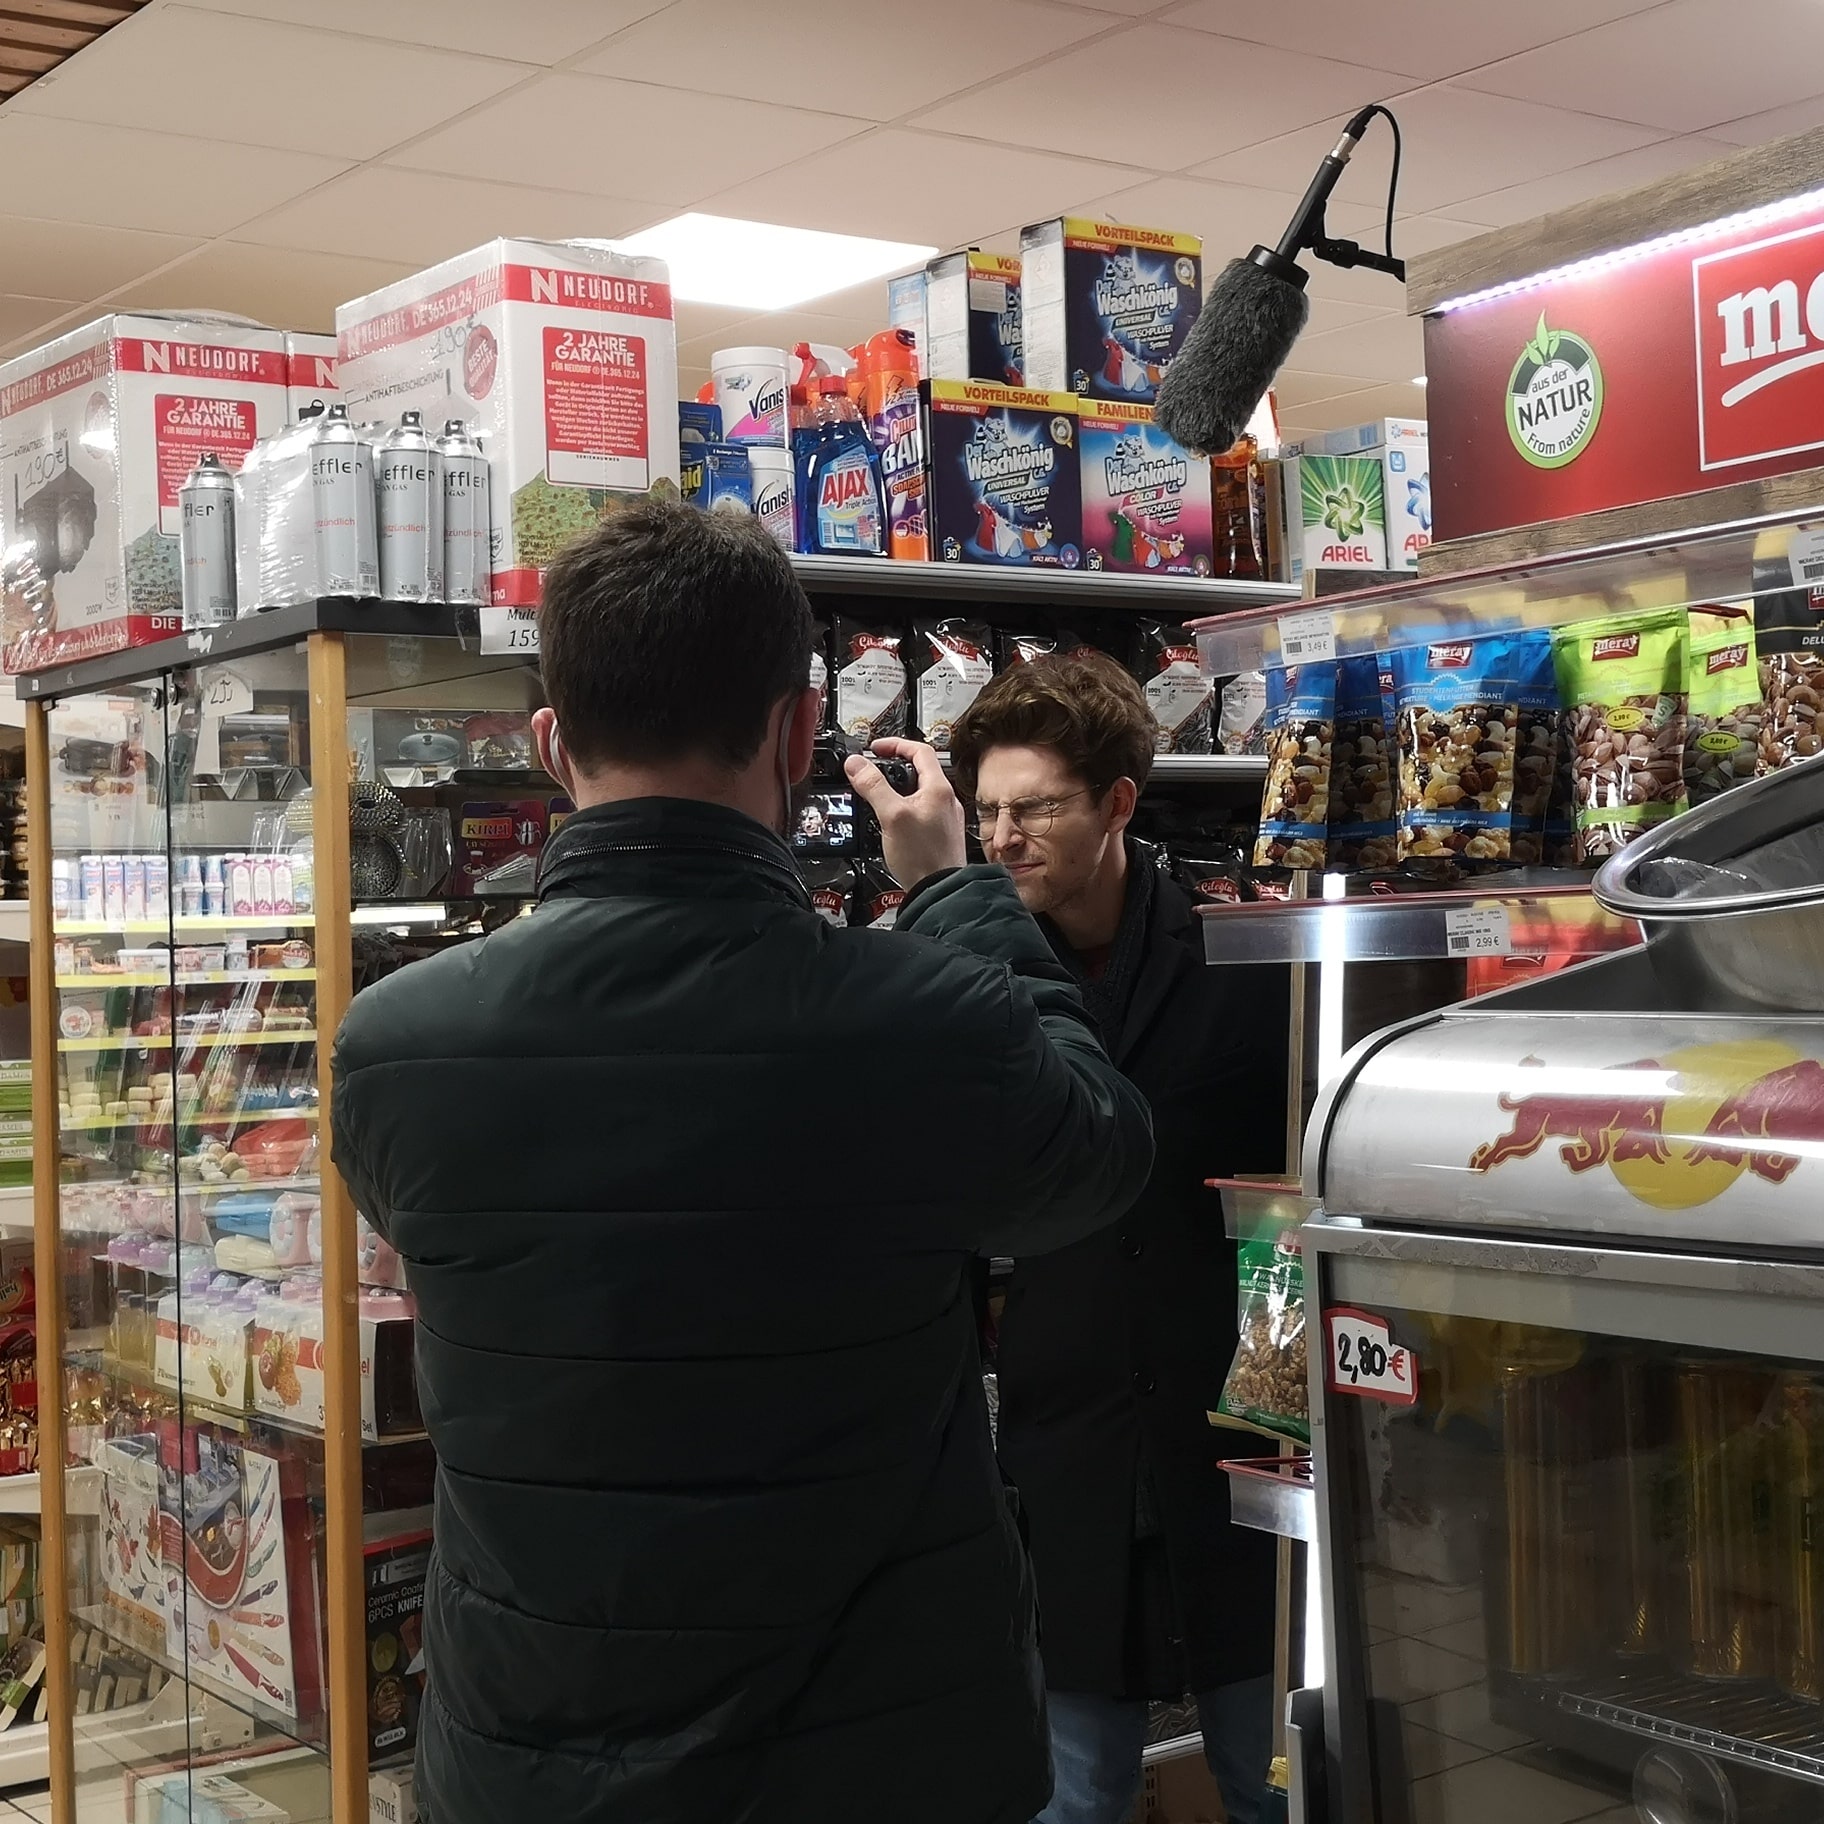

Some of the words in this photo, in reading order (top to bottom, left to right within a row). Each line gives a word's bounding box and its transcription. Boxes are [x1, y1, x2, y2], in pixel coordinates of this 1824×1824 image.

[1095, 224, 1175, 247] VORTEILSPACK
[564, 275, 648, 306] NEUDORF
[1097, 282, 1178, 316] Waschkönig
[1128, 325, 1173, 340] WASCHPULVER
[563, 332, 573, 347] 2
[578, 334, 628, 352] JAHRE
[176, 344, 260, 373] NEUDORF
[467, 338, 489, 372] BESTE
[555, 345, 635, 368] GARANTIE
[564, 362, 591, 374] NEUDORF
[1076, 380, 1087, 391] 30
[1532, 378, 1550, 393] aus
[1552, 368, 1568, 383] der
[964, 386, 1050, 406] VORTEILSPACK
[1518, 378, 1592, 431] NATUR
[175, 398, 185, 411] 2
[190, 399, 238, 416] JAHRE
[167, 411, 245, 429] GARANTIE
[1528, 433, 1555, 454] From
[1559, 409, 1590, 452] nature
[966, 444, 983, 459] Der
[967, 444, 1054, 482] Waschkönig
[1106, 458, 1124, 473] Der
[681, 466, 701, 489] aid
[987, 477, 1026, 490] UNIVERSAL
[1107, 458, 1186, 495] Waschkönig
[822, 467, 870, 509] AJAX
[1000, 486, 1049, 504] WASCHPULVER
[1130, 491, 1157, 502] COLOR
[1023, 503, 1045, 514] System
[1137, 500, 1182, 516] WASCHPULVER
[947, 548, 958, 560] 30
[1321, 545, 1373, 562] ARIEL
[1089, 560, 1099, 570] 30
[152, 617, 176, 630] DIE
[1308, 641, 1321, 653] 3,49
[1323, 641, 1328, 650] €
[1596, 635, 1637, 650] meray
[1709, 648, 1745, 664] meray
[1476, 937, 1493, 948] 2,99
[1494, 936, 1499, 945] €
[368, 1591, 399, 1607] Ceramic
[369, 1603, 393, 1623] 6PCS
[398, 1594, 423, 1613] KNIFE
